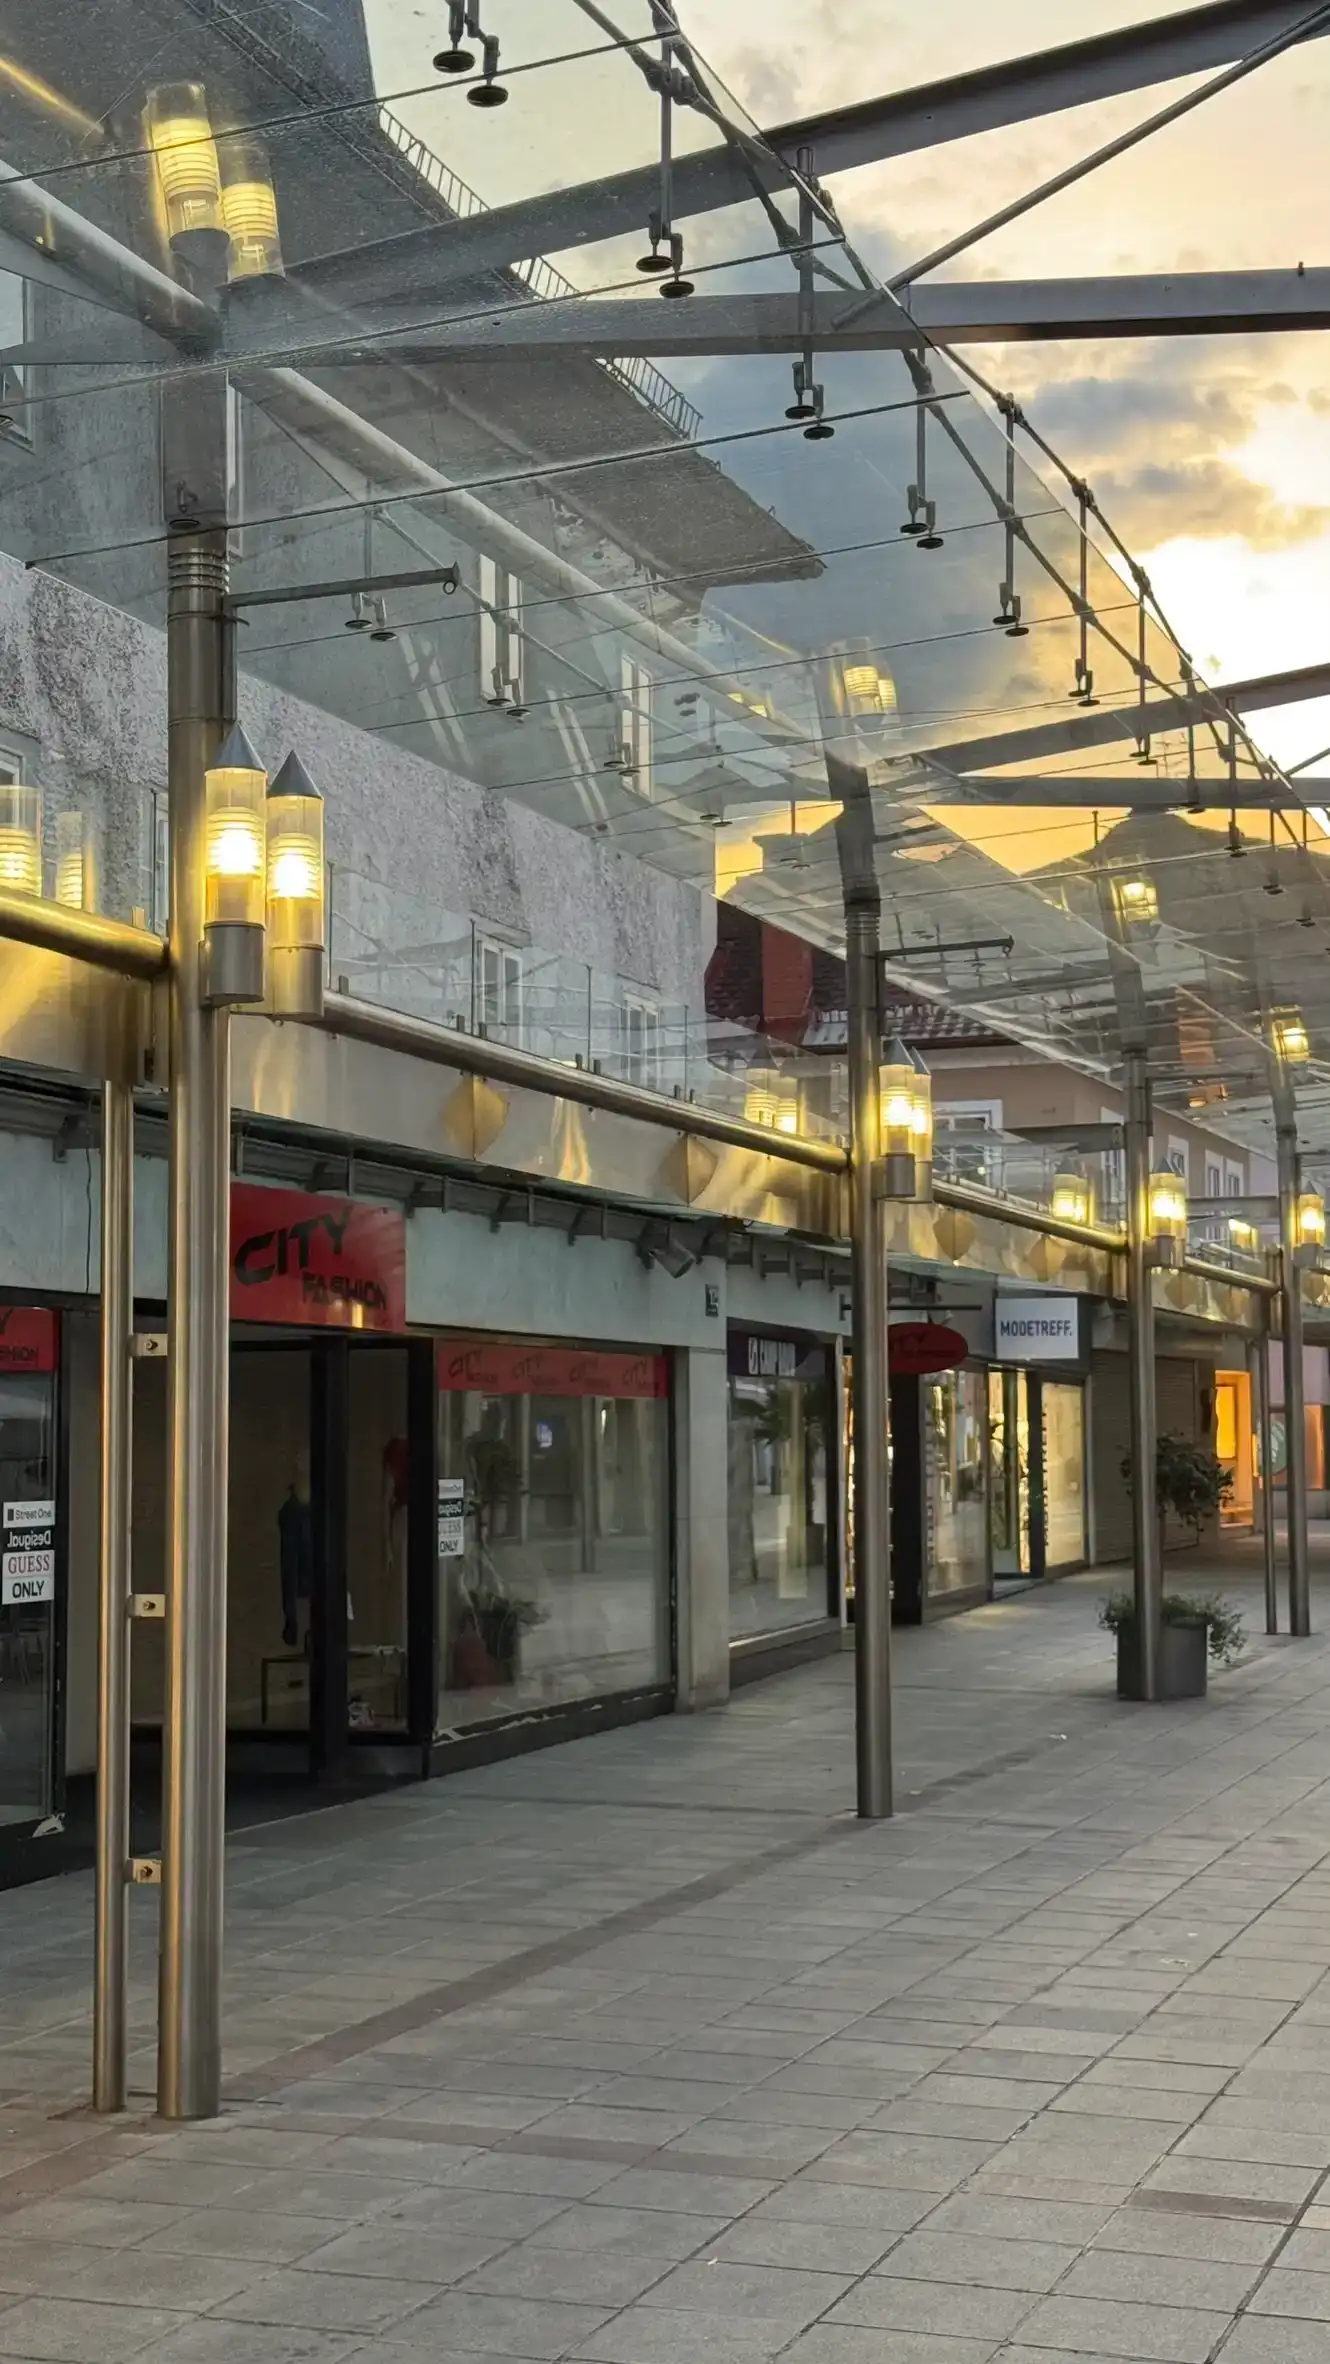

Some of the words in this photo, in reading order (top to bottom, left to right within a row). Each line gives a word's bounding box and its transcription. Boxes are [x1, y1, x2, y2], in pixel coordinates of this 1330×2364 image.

[235, 1204, 354, 1287] CITY
[301, 1271, 388, 1310] FASHION
[8, 1554, 50, 1574] GUESS
[12, 1580, 45, 1598] ONLY
